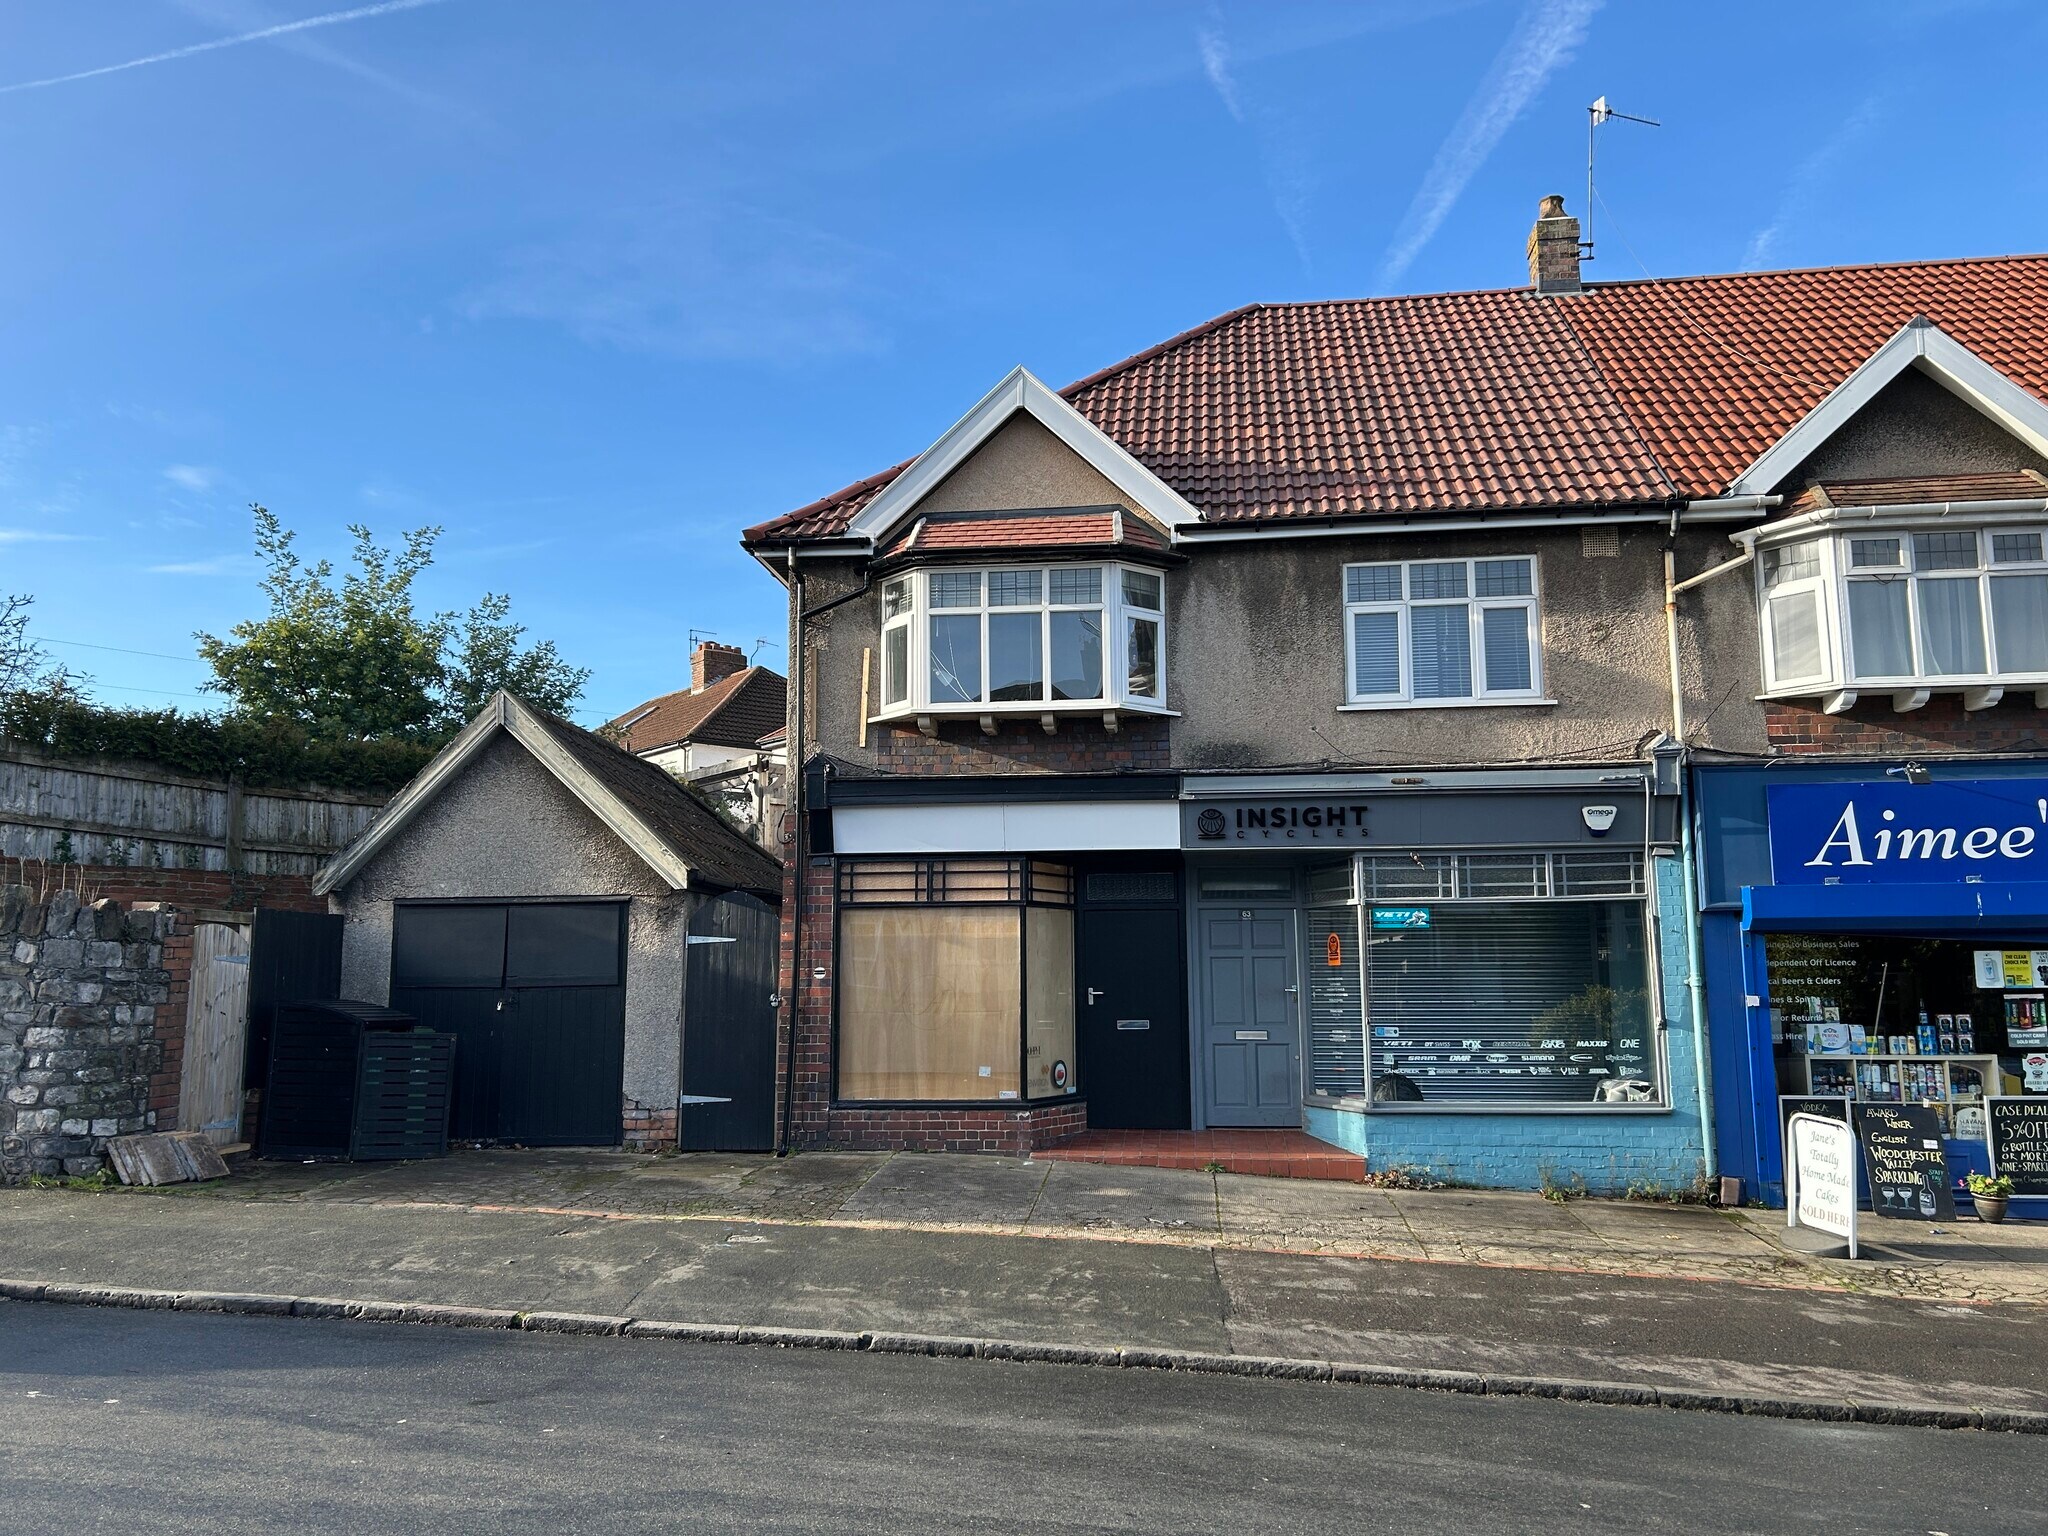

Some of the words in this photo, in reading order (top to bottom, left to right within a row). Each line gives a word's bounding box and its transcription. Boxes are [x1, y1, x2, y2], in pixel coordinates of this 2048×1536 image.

[1236, 806, 1368, 828] INSIGHT
[1237, 828, 1368, 839] CYCLES
[1804, 798, 2047, 866] Aimee'
[1766, 940, 1790, 948] siness
[1802, 940, 1837, 948] Business
[1838, 940, 1860, 948] Sales
[1766, 959, 1808, 967] dependent
[1809, 959, 1823, 967] Off
[1824, 959, 1857, 967] Licence
[1768, 977, 1780, 985] cal
[1781, 977, 1805, 985] Beers
[1806, 977, 1813, 985] &
[1815, 977, 1841, 985] Ciders
[1462, 1040, 1482, 1050] FOX
[1801, 1102, 1829, 1112] VODKA
[1995, 1105, 2022, 1116] CASE
[1866, 1108, 1899, 1118] AWARD
[1810, 1130, 1836, 1146] Jane's
[2001, 1142, 2009, 1152] 6
[2010, 1141, 2048, 1152] BOTTLES
[1809, 1148, 1839, 1169] Totally
[1870, 1146, 1945, 1165] WOODCHESTER
[2001, 1152, 2018, 1161] OR
[2020, 1151, 2048, 1161] MORE
[1883, 1158, 1916, 1169] VALLEY
[1801, 1165, 1826, 1182] Home
[1875, 1166, 1923, 1185] SPARKLING
[1815, 1188, 1840, 1205] Cakes
[1801, 1203, 1826, 1220] SOLD
